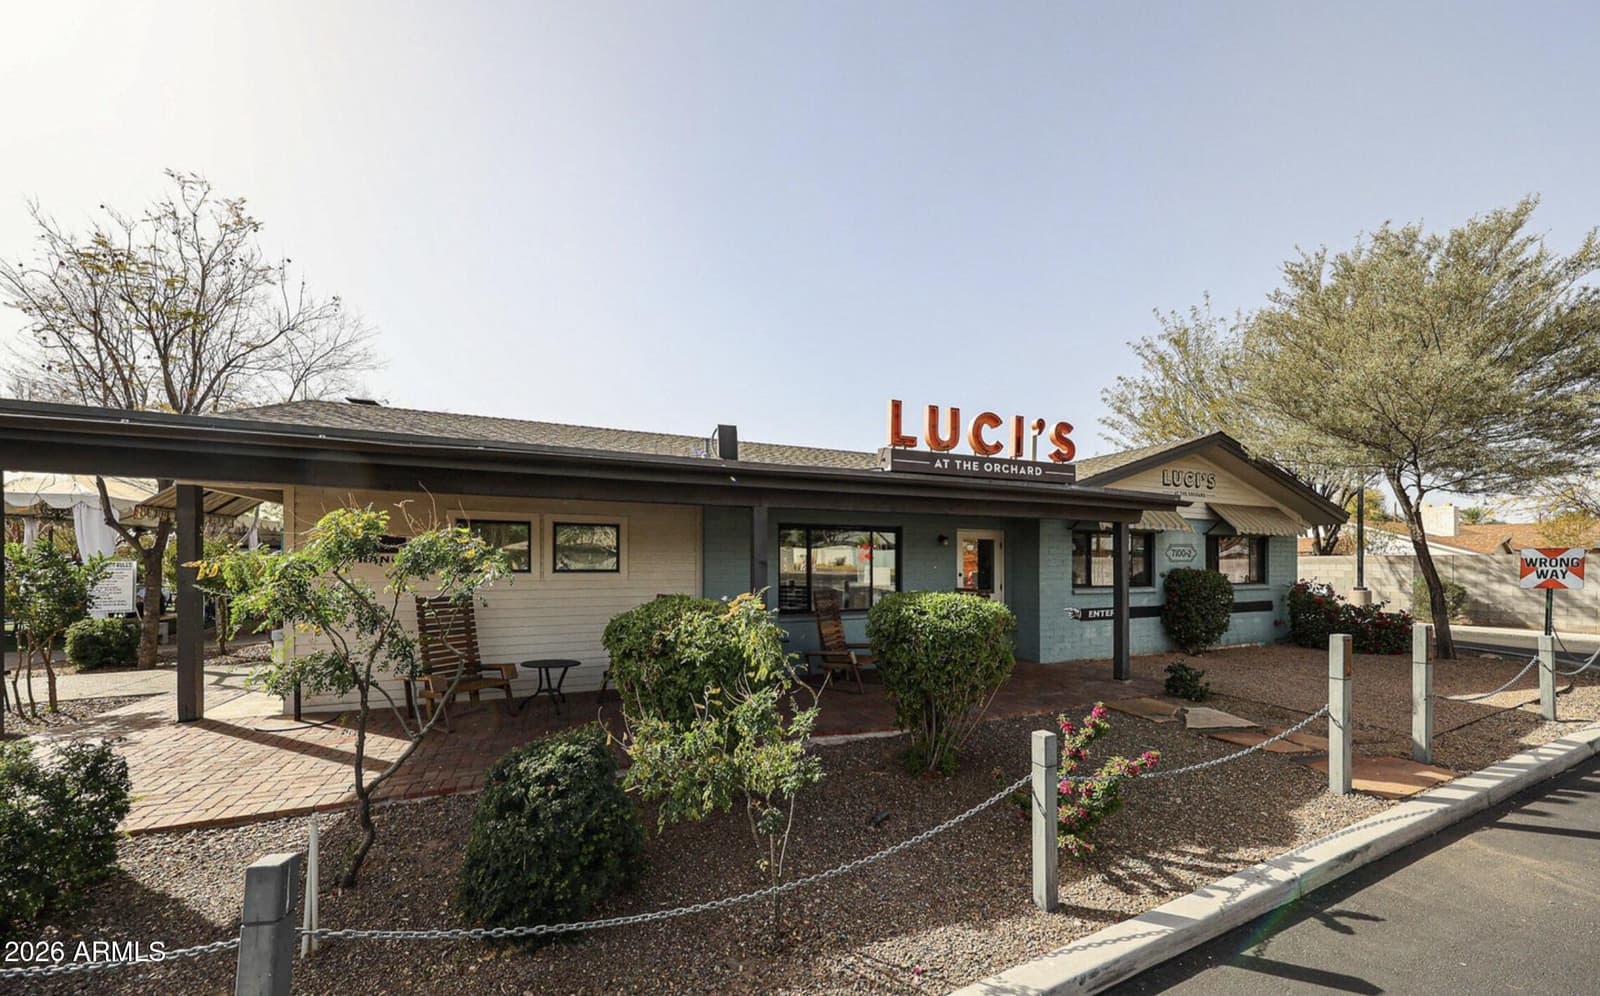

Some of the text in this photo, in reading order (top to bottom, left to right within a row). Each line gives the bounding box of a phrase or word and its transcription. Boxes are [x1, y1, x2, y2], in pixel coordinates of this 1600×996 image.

[889, 399, 1076, 463] LUCI'S
[934, 458, 1043, 476] AT THE ORCHARD
[1162, 469, 1216, 490] LUCI'S
[1524, 557, 1580, 568] WRONG
[1535, 569, 1569, 579] WAY
